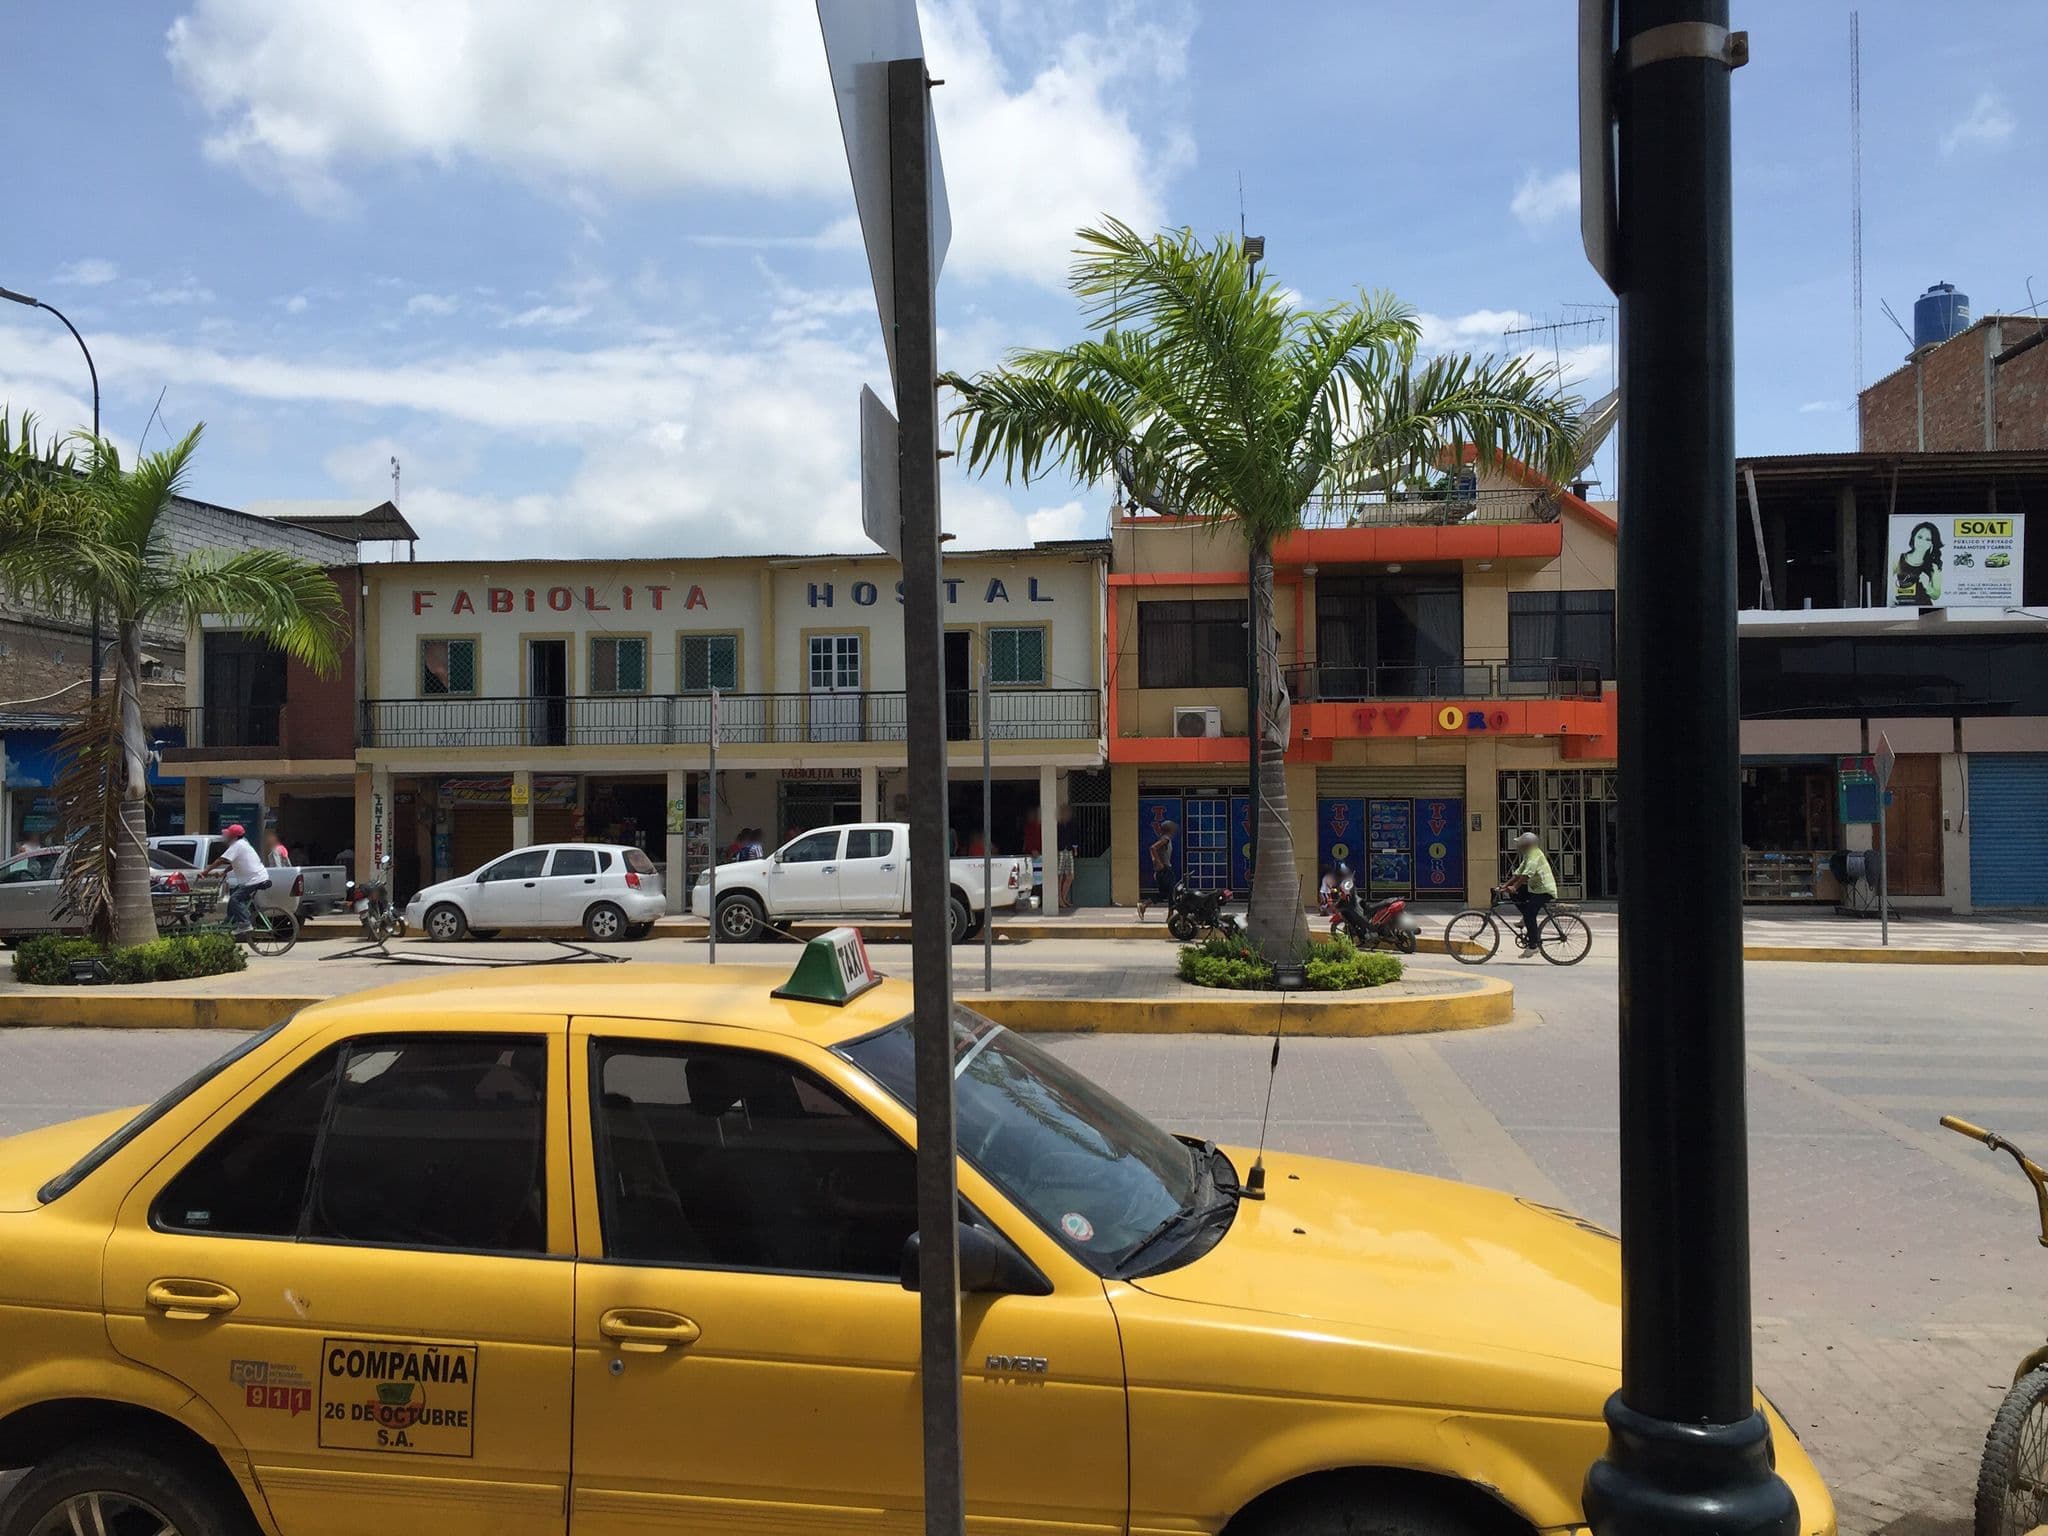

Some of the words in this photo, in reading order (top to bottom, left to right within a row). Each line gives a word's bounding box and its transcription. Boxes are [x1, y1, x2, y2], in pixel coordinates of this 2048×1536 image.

[1960, 521, 2008, 535] SOAT
[1353, 706, 1410, 733] TV
[1438, 706, 1509, 731] ORO
[374, 793, 383, 870] INTERNET
[1329, 804, 1349, 838] TV
[1427, 803, 1447, 836] TV
[1428, 842, 1447, 884] ORO
[838, 939, 864, 983] TAXI
[328, 1346, 468, 1384] COMPAÑIA
[251, 1387, 304, 1409] 911
[324, 1402, 345, 1420] 26
[351, 1403, 374, 1422] DE
[380, 1404, 468, 1428] OCTUBRE
[377, 1429, 414, 1448] S.A.
